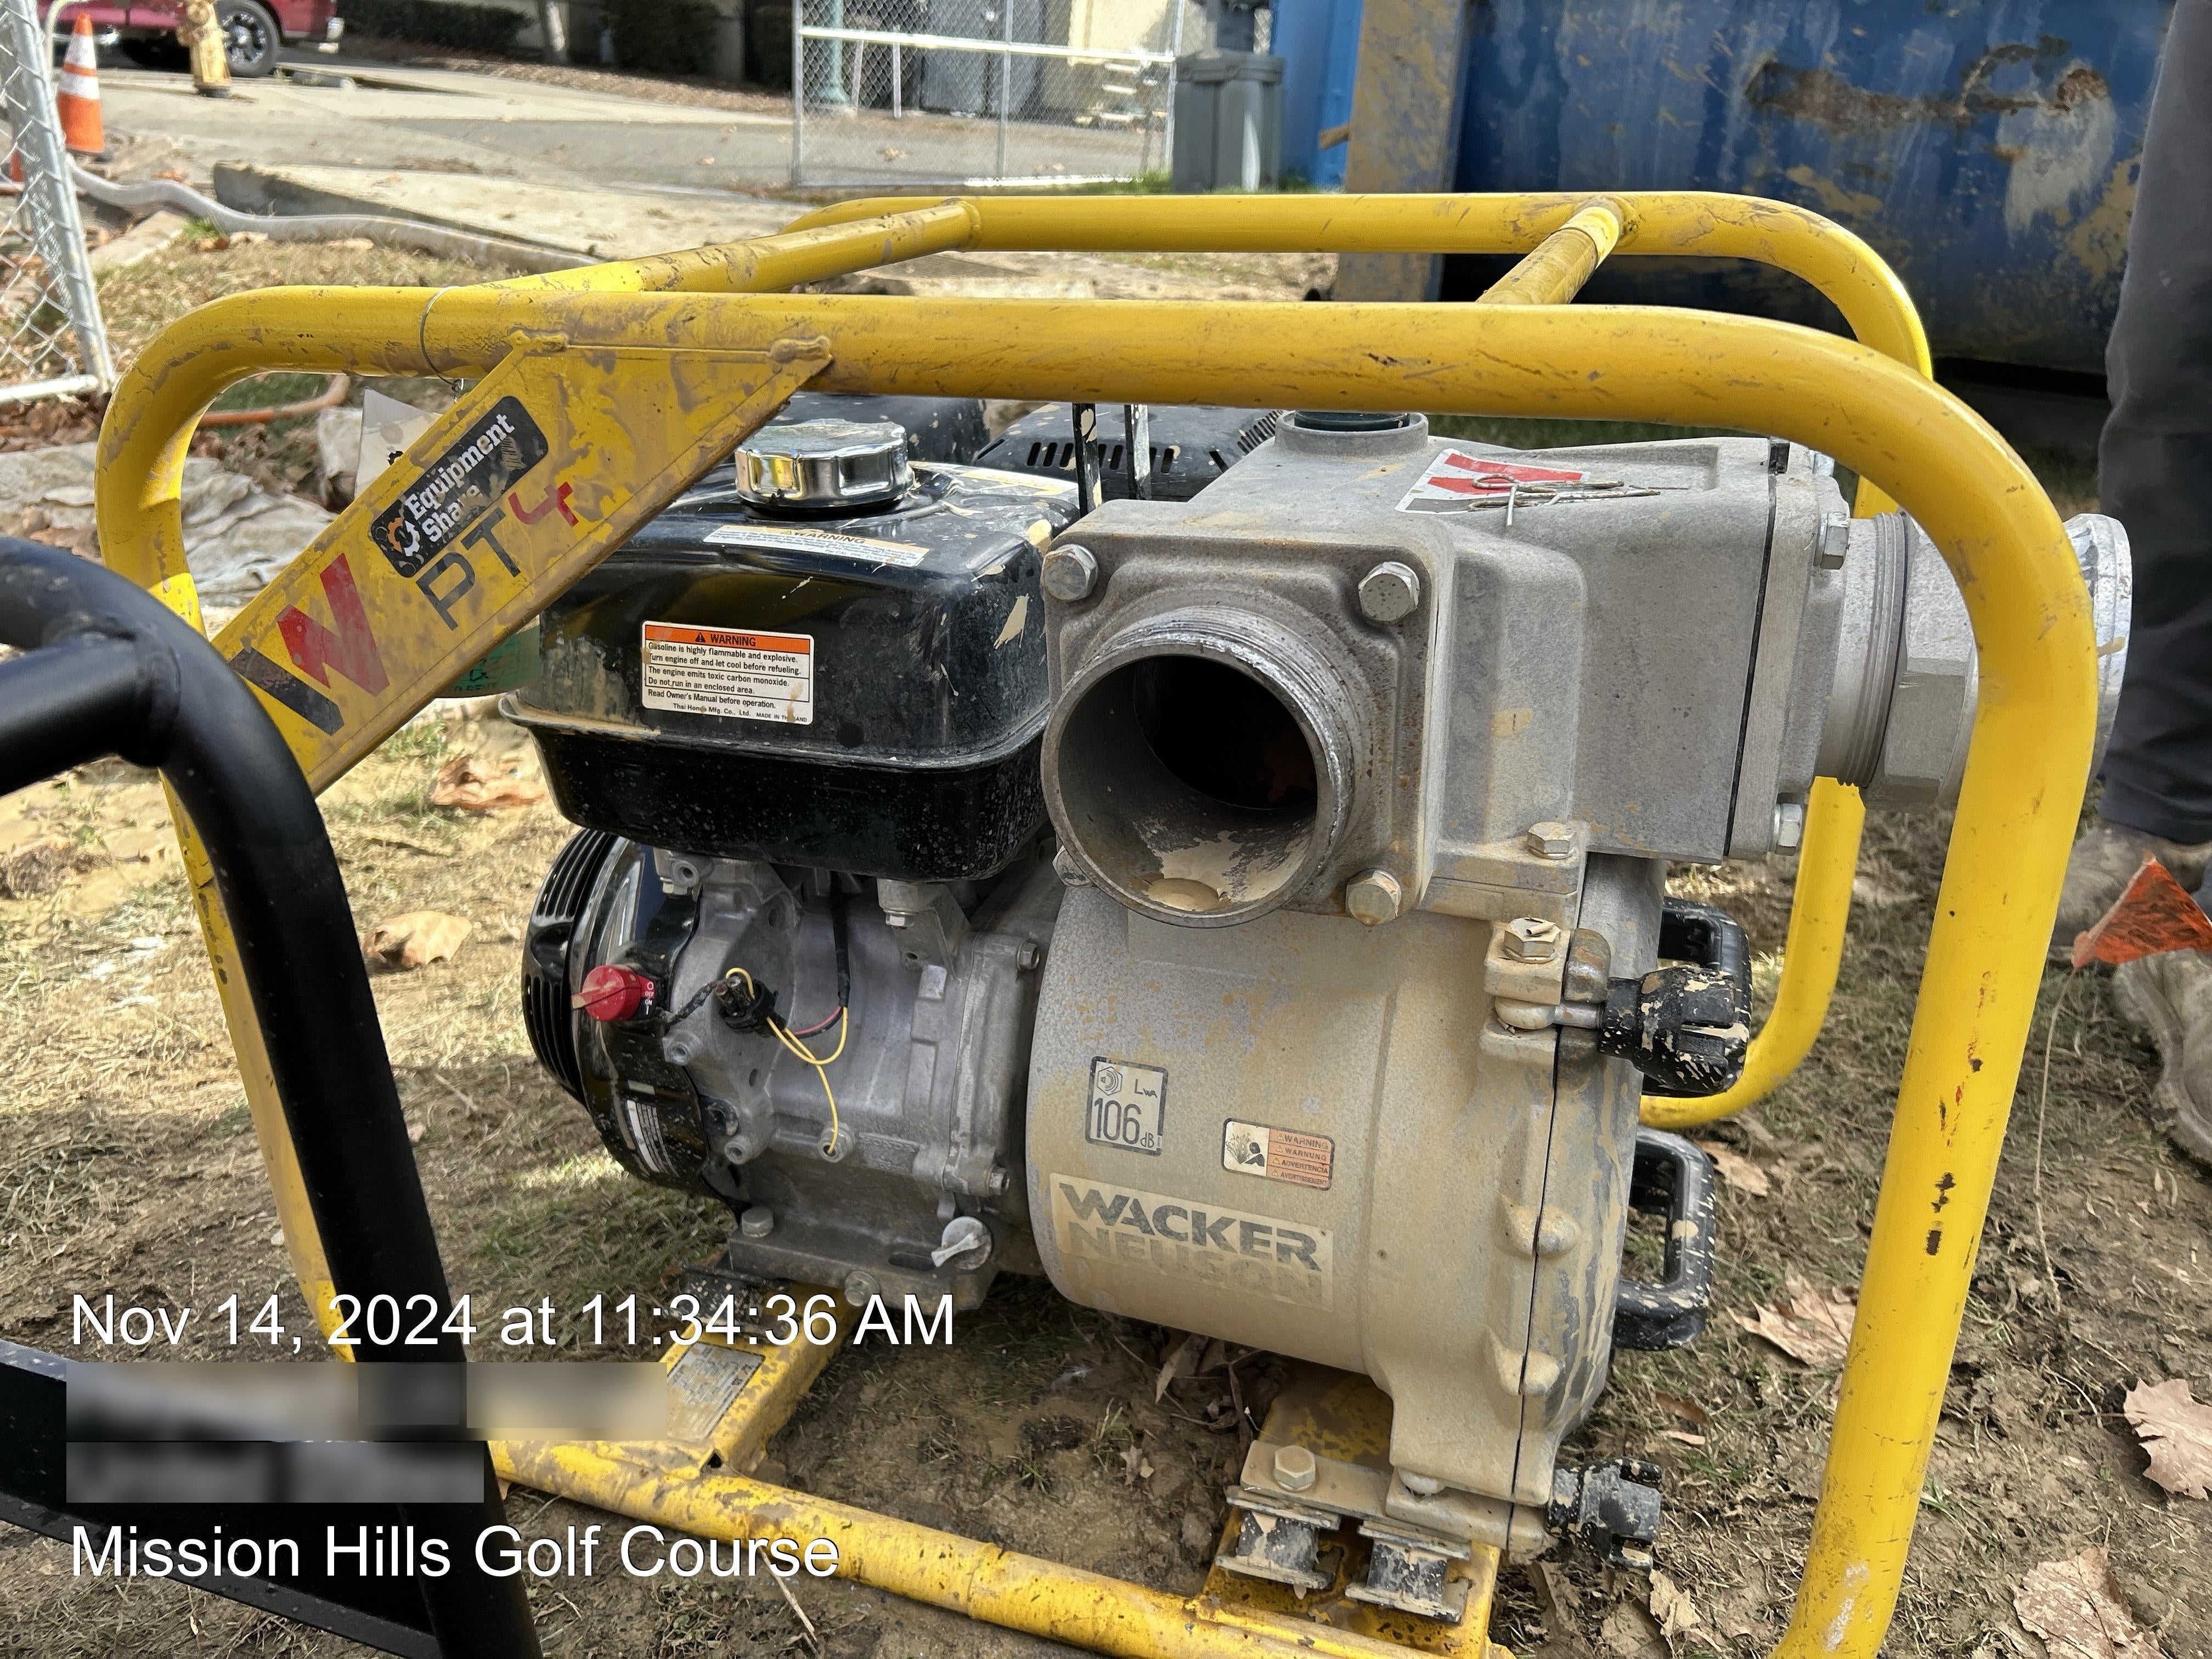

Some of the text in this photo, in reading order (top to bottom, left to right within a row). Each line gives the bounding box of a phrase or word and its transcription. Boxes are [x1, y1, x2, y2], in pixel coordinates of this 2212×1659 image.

[404, 413, 515, 521] Equipment
[795, 531, 865, 544] WARNING
[710, 634, 756, 647] WARNING
[648, 642, 676, 652] Gasoline
[686, 646, 707, 656] highly
[709, 648, 746, 658] flammable
[763, 653, 798, 663] explosive.
[650, 653, 663, 661] Turn
[665, 656, 687, 664] engine
[743, 662, 766, 671] before
[768, 664, 802, 676] refueling.
[648, 666, 661, 674] The
[663, 668, 685, 676] engine
[687, 670, 706, 679] emits
[708, 672, 725, 680] toxic
[753, 678, 789, 687] monoxide.
[704, 683, 735, 692] enclosed
[648, 689, 776, 709] Read Owner's Manual before operation.
[1094, 1097, 1154, 1148] 106 dB
[1284, 1134, 1329, 1150] WARNING
[1285, 1147, 1327, 1161] WARNUNG
[1281, 1160, 1329, 1175] ADVERTENCIA
[1280, 1171, 1328, 1186] AVERTISSEMENT
[1059, 1182, 1322, 1272] WACKER
[1067, 1221, 1323, 1305] NEUSON
